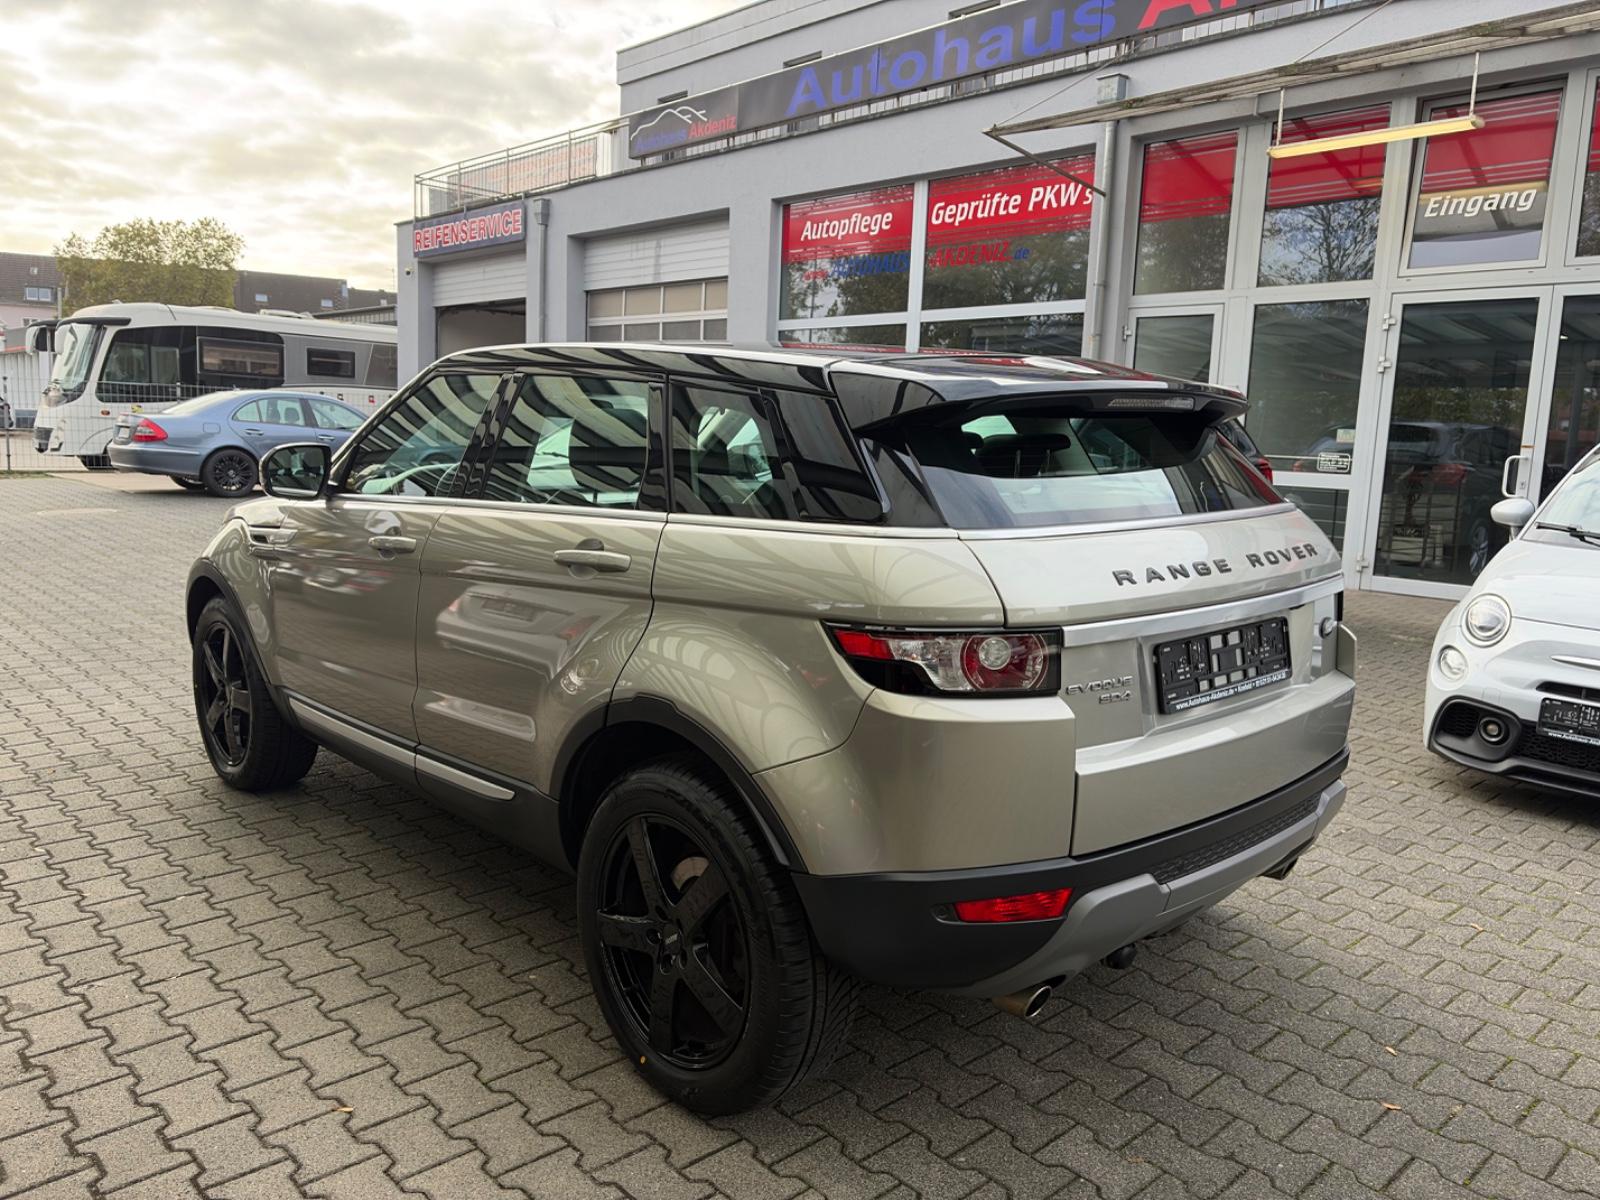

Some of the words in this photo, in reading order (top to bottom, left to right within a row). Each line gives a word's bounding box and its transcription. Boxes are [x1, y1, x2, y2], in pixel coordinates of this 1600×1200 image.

[784, 0, 1117, 116] Autohaus
[688, 114, 737, 139] Akdeniz
[931, 192, 1021, 226] Geprüfte
[1028, 182, 1093, 212] PKWs
[1424, 189, 1537, 217] Eingang
[414, 208, 522, 252] REIFENSERVICE
[801, 210, 893, 241] Autopflege
[1112, 559, 1232, 587] RANGE
[1246, 543, 1318, 569] ROVER
[1064, 675, 1133, 696] EVOQUE
